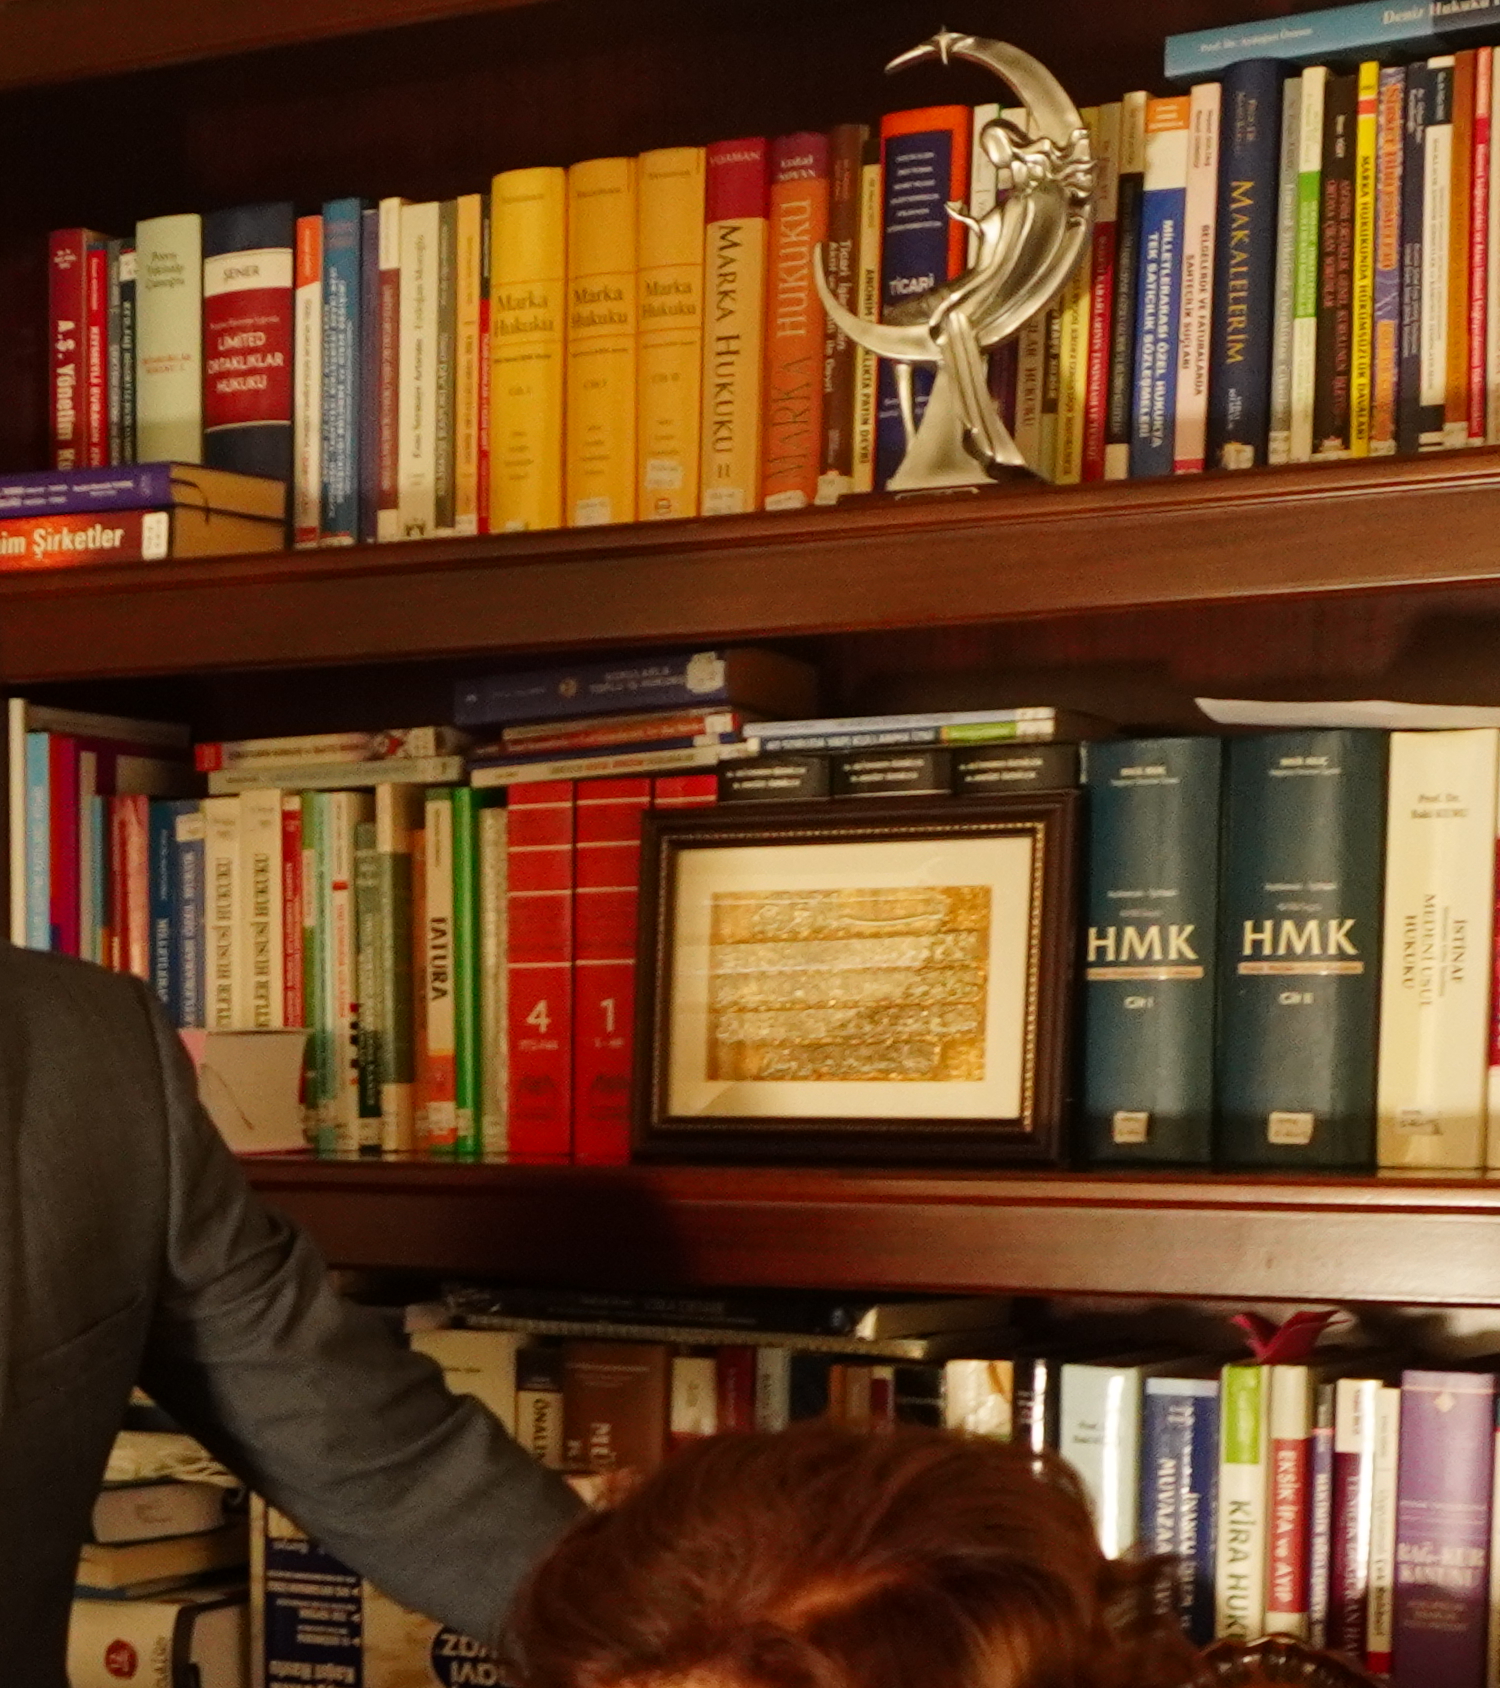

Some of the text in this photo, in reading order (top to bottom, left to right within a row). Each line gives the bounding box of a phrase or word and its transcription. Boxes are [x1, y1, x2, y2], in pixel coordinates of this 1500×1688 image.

[776, 199, 812, 338] HUKUKU
[1147, 231, 1161, 260] TEK
[571, 286, 623, 304] Marka
[643, 278, 694, 298] Marka
[715, 225, 744, 322] MARKA
[1157, 219, 1175, 337] MİLLETLERARASI
[1226, 180, 1255, 365] MAKALELERİM
[641, 300, 697, 321] Hukuku
[1143, 263, 1158, 329] SATICILIK
[1155, 341, 1169, 376] ÖZEL
[55, 362, 78, 441] Yönetim
[713, 333, 740, 454] HUKUKU
[32, 523, 125, 560] Şirketler
[1087, 924, 1198, 962] HMK
[1242, 918, 1359, 956] HMK
[1401, 915, 1418, 991] HUKUKU
[525, 998, 552, 1035] 4
[599, 997, 616, 1034] 1
[1275, 1449, 1301, 1500] EKSİK
[1175, 1457, 1198, 1556] MUVAZAA
[1227, 1500, 1257, 1563] KİRA
[1272, 1561, 1294, 1603] AYIP
